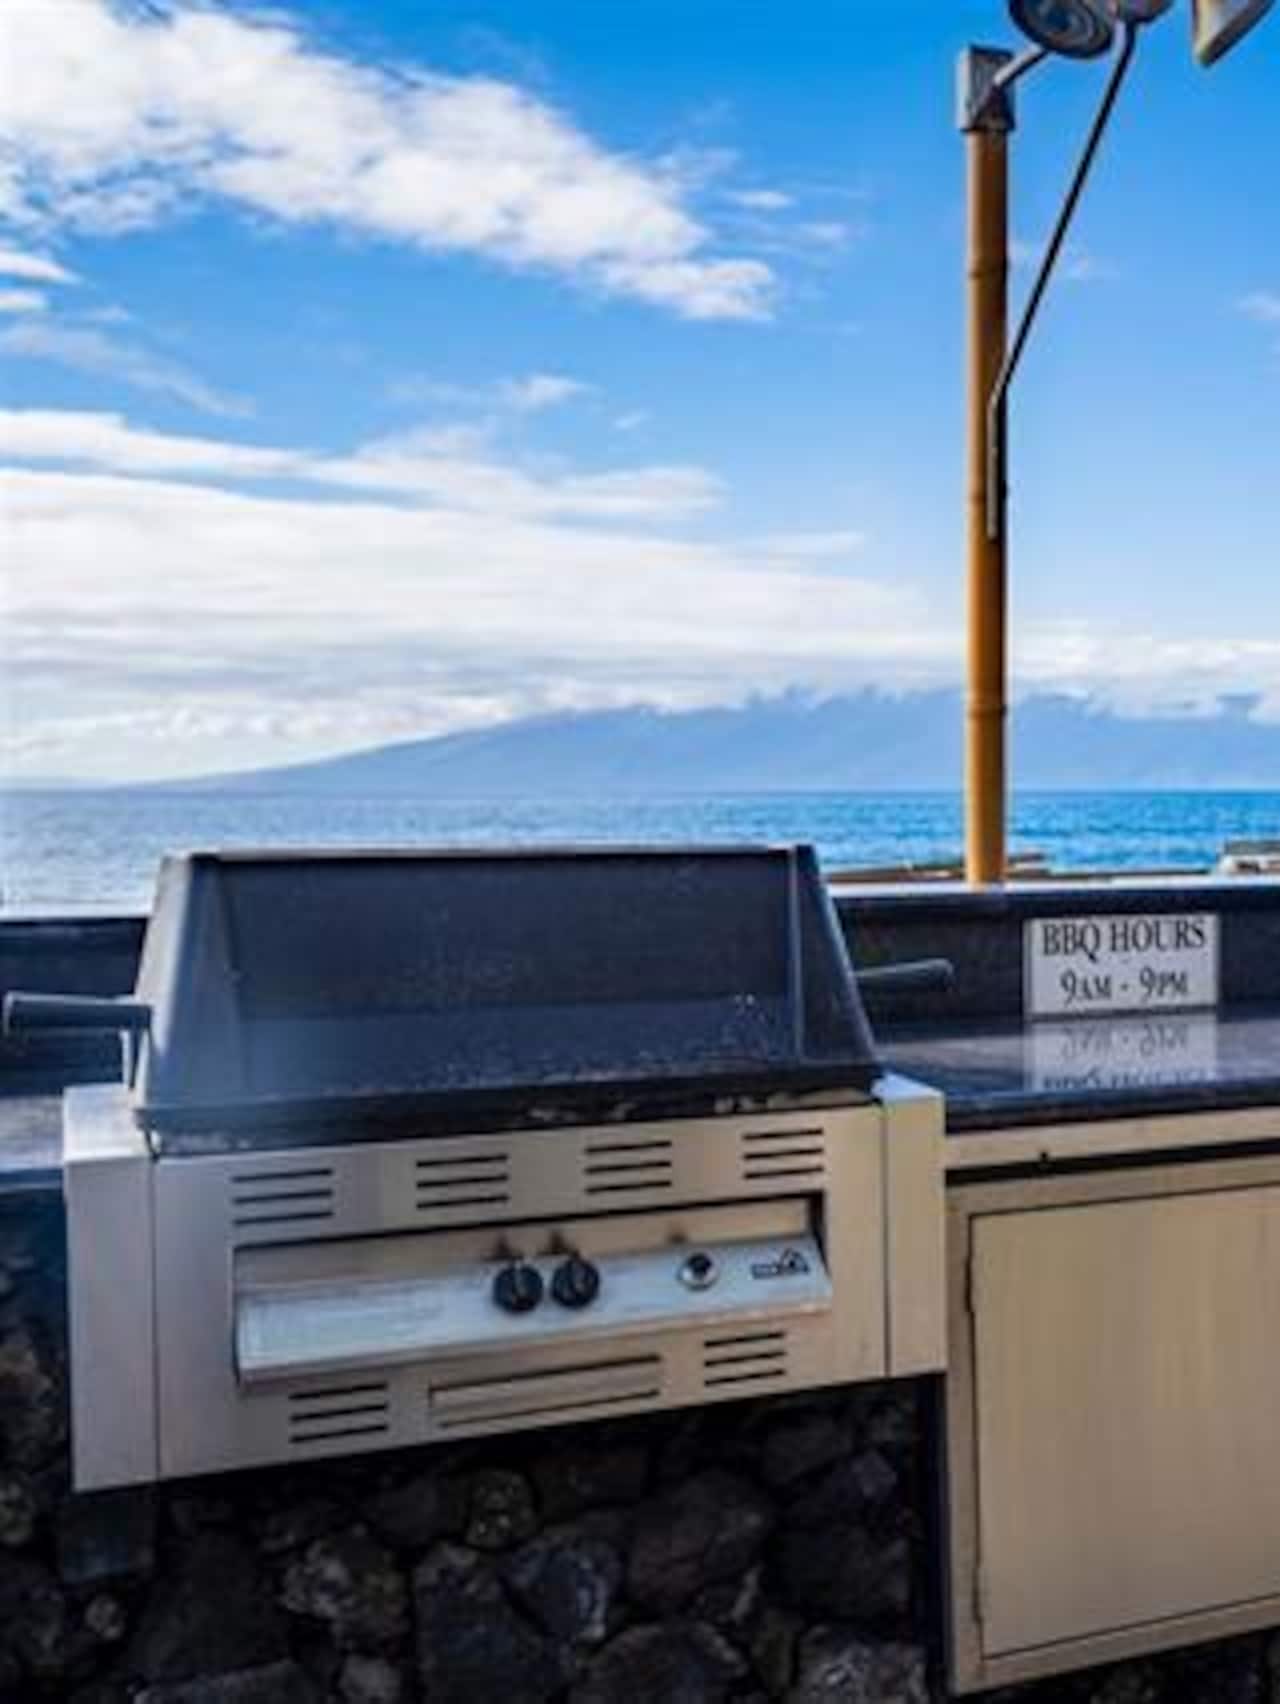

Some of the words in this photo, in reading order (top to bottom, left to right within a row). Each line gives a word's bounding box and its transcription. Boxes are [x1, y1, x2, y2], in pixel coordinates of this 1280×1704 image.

[1042, 922, 1100, 963] BBQ
[1110, 918, 1206, 951] HOURS
[1059, 967, 1112, 1006] 9AM
[1138, 964, 1188, 1000] 9PM
